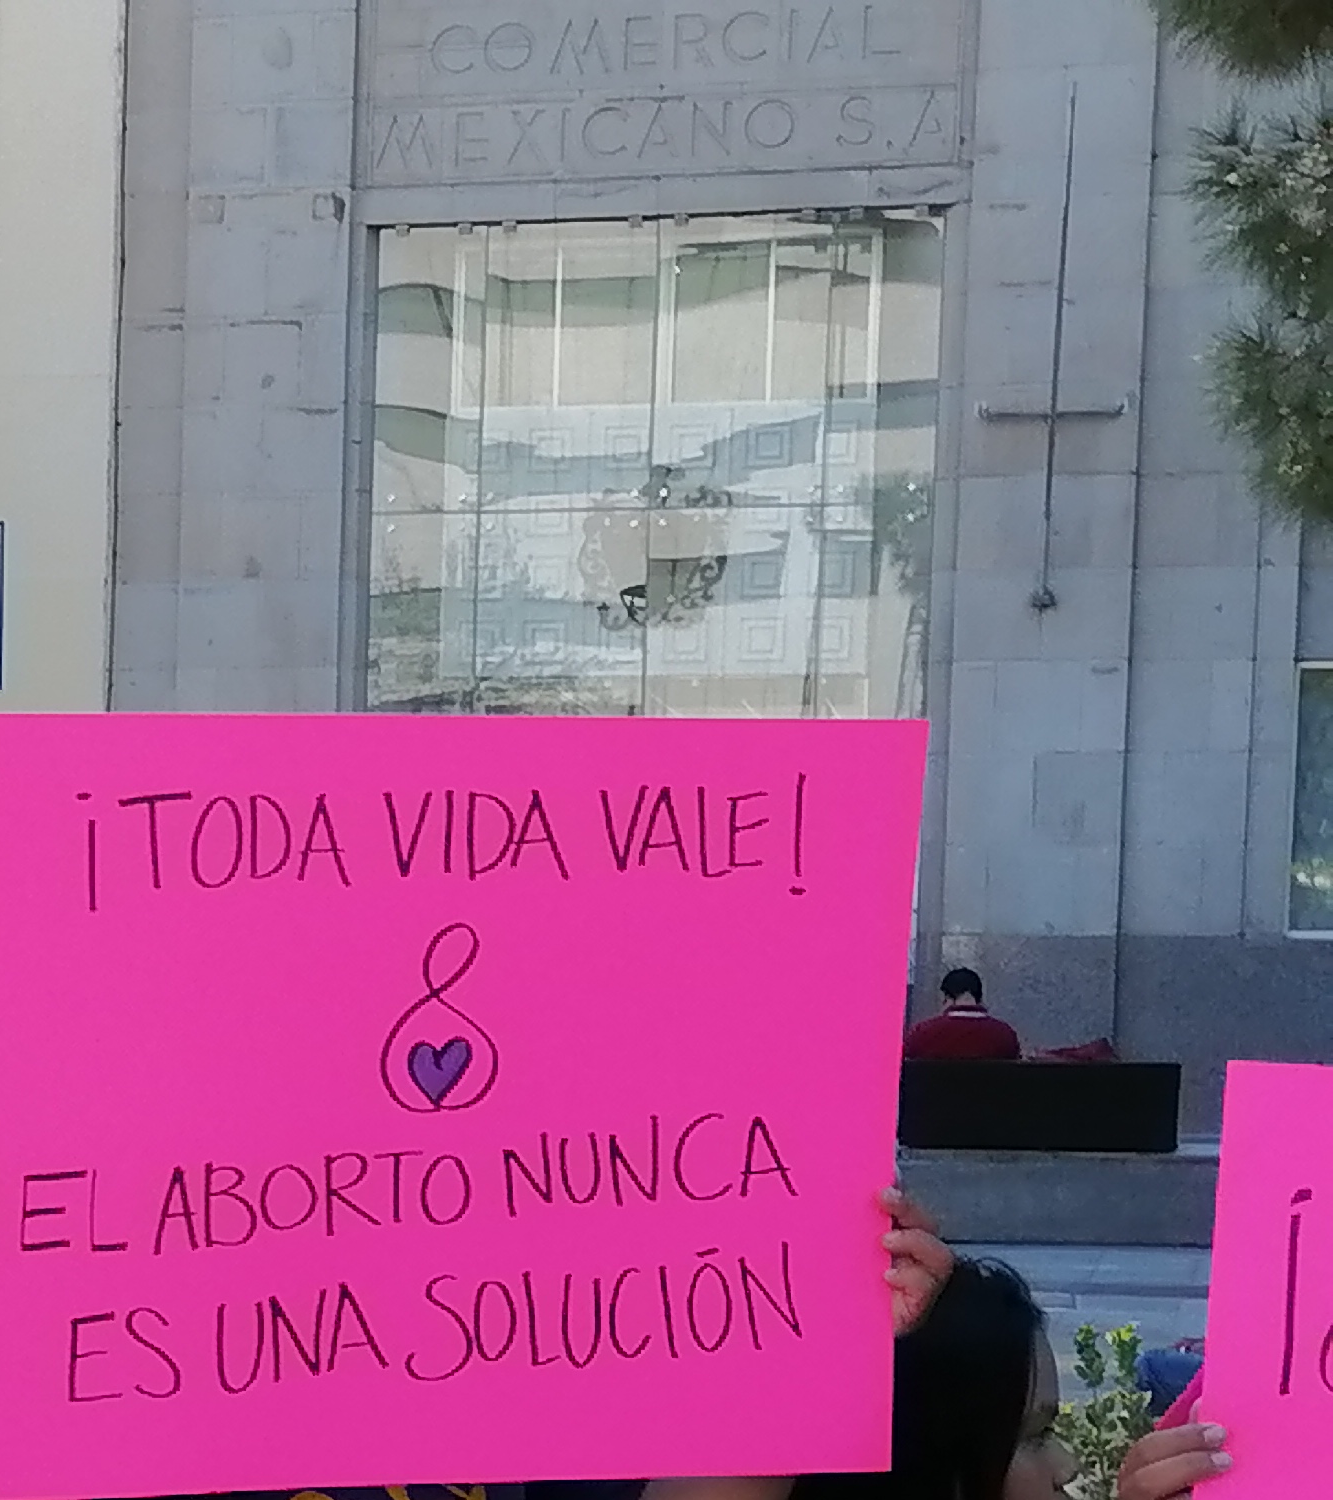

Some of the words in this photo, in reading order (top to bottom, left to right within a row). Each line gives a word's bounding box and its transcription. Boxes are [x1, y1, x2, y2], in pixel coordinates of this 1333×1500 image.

[430, 4, 902, 75] COMERCIAL
[375, 98, 797, 170] MEXICANO
[76, 790, 353, 912] ¡TODA
[383, 788, 571, 882] VIDA
[599, 771, 808, 896] VALE!
[18, 1168, 129, 1253] EL
[153, 1150, 474, 1257] ABORTO
[501, 1112, 801, 1219] NUNCA
[67, 1307, 182, 1402] ES
[215, 1281, 390, 1396] UNA
[404, 1240, 803, 1382] SOLUCIÓN
